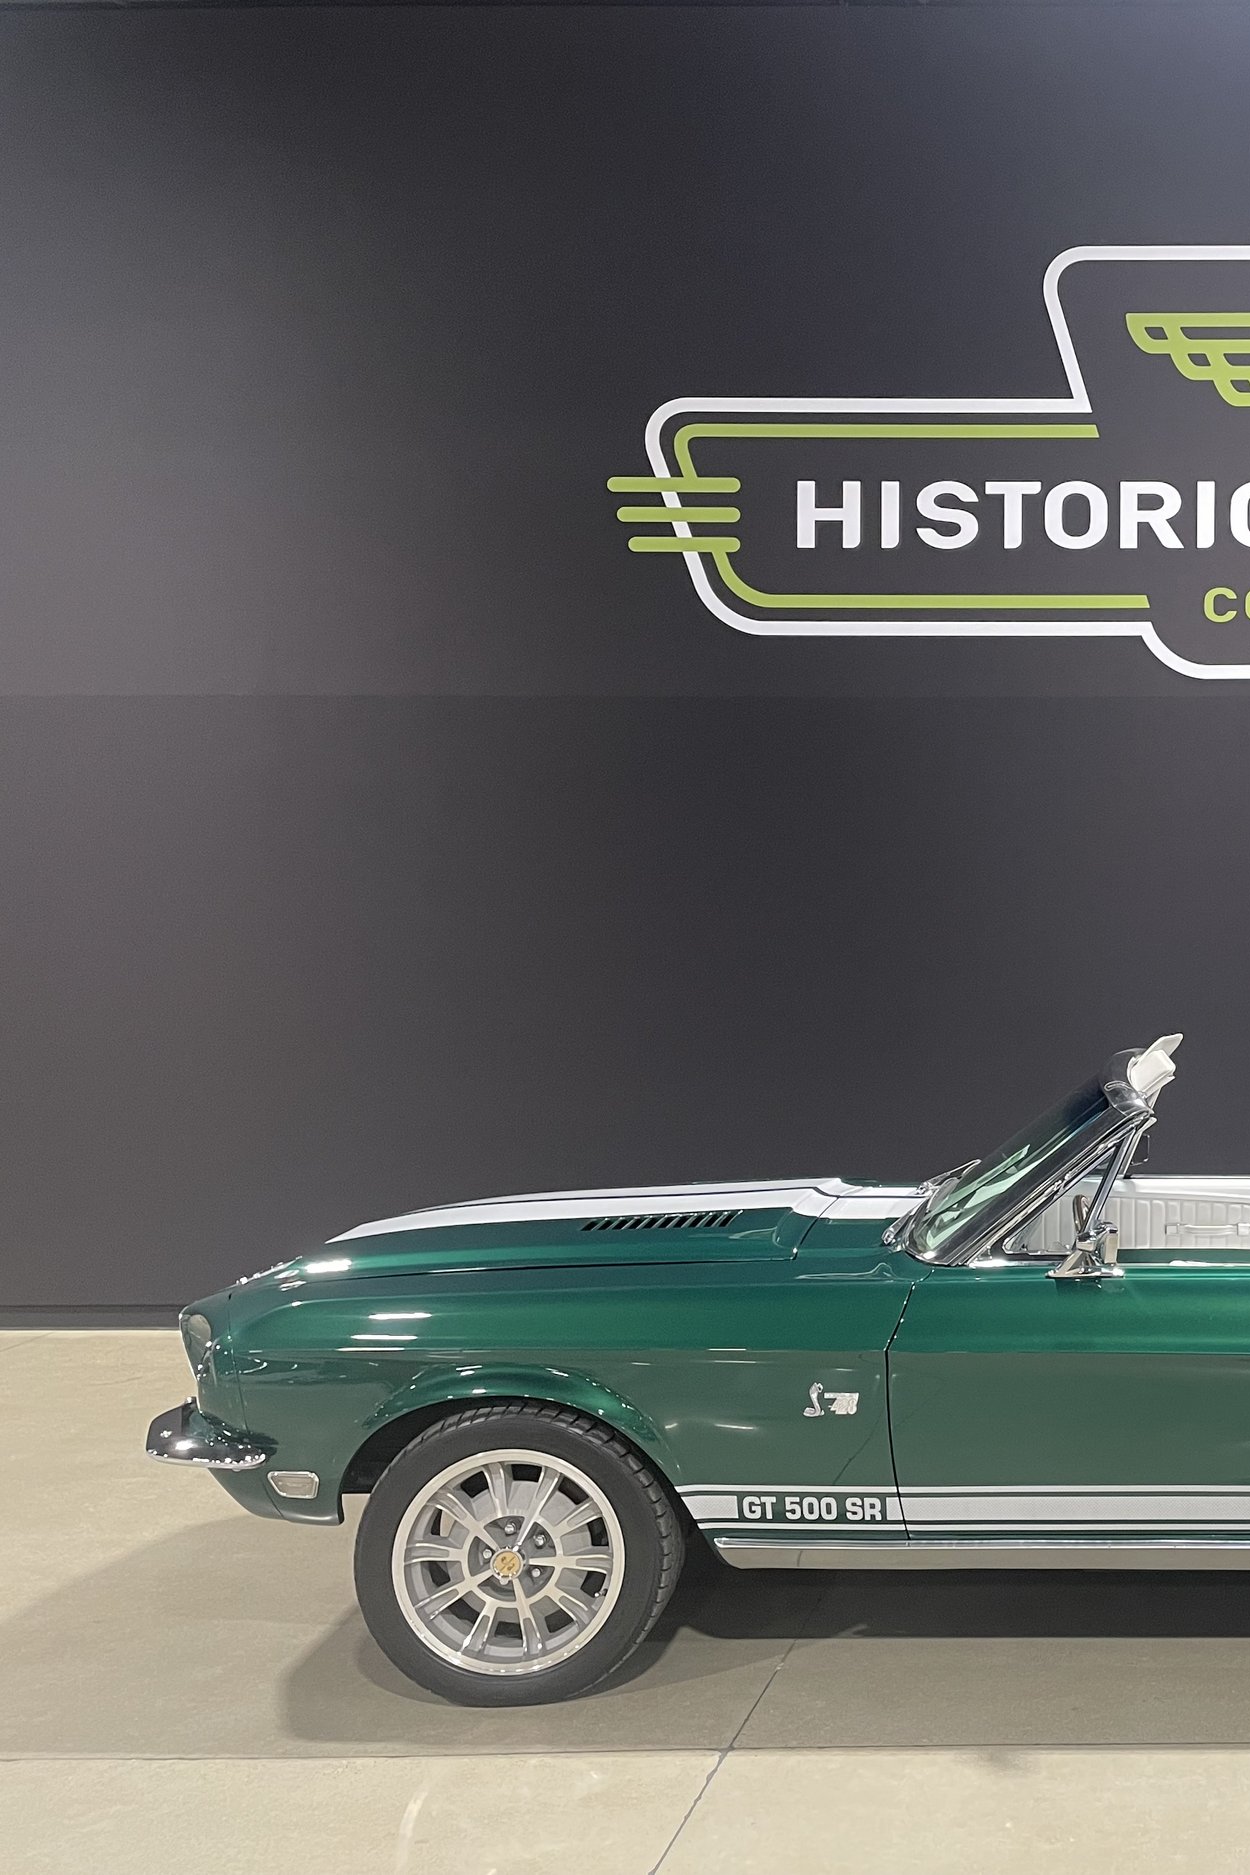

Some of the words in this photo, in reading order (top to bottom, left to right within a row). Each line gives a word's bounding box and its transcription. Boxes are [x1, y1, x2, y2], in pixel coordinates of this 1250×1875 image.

[741, 1496, 777, 1521] GT
[784, 1496, 838, 1521] 500
[844, 1497, 883, 1521] SR
